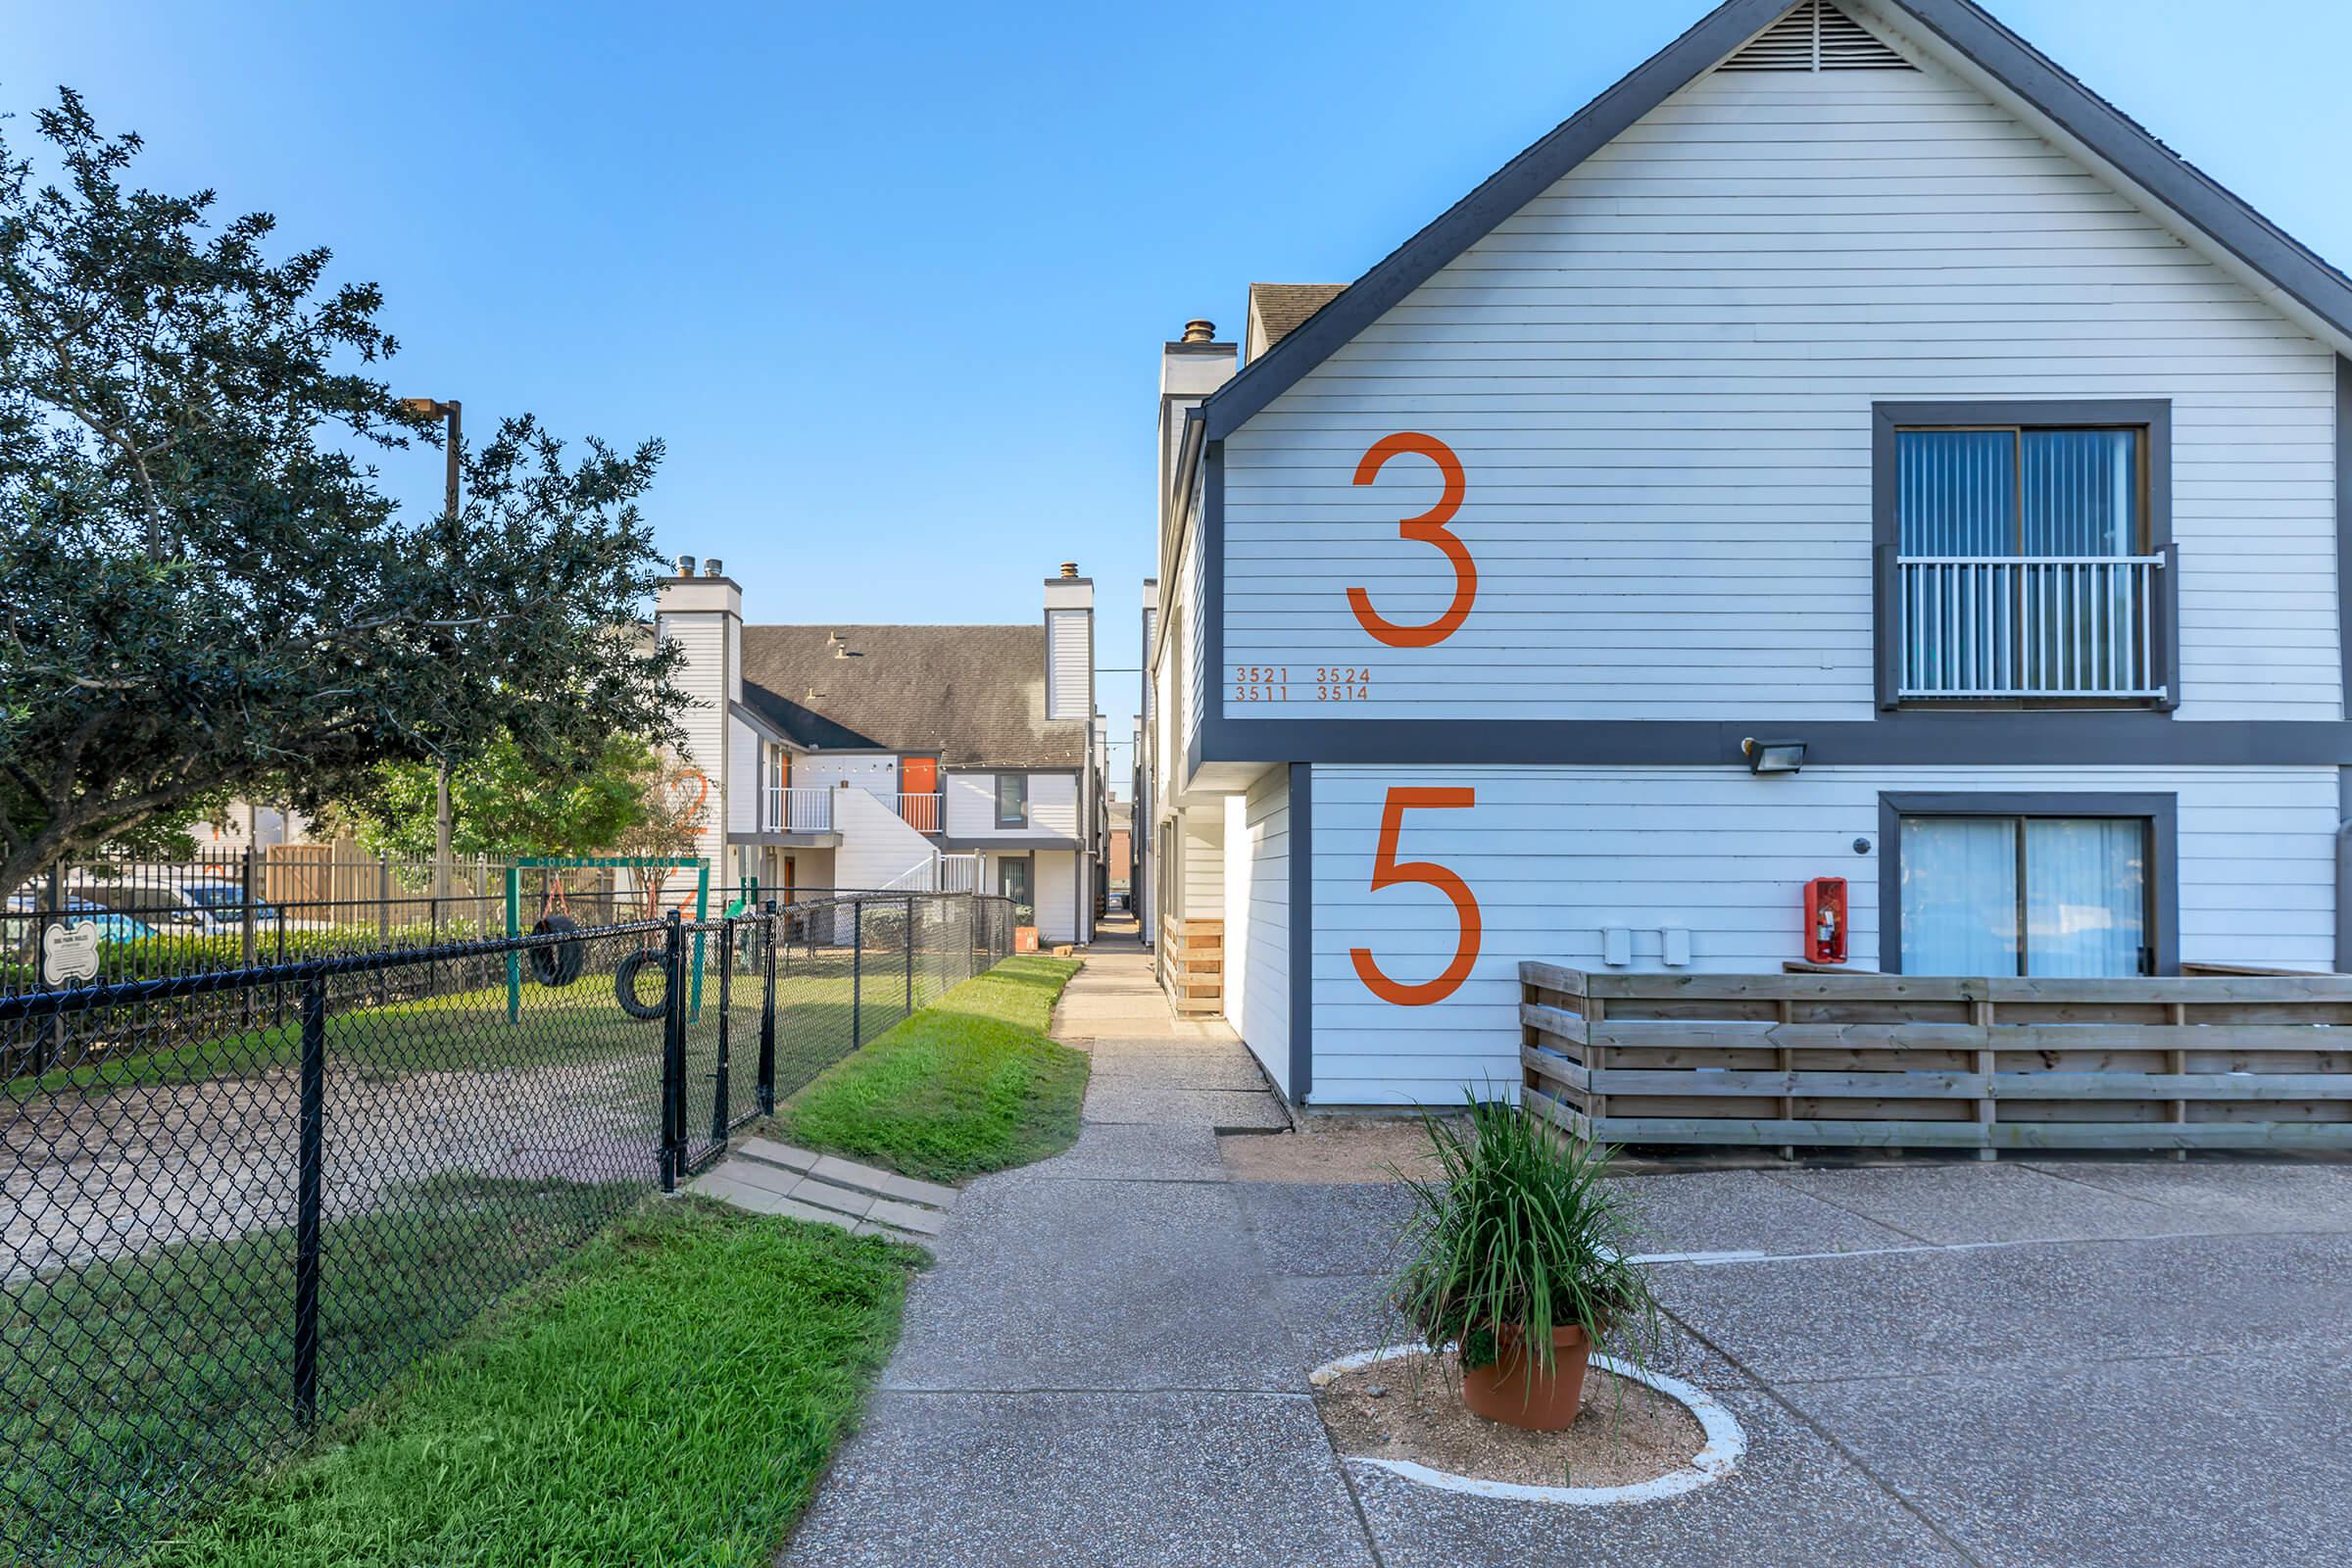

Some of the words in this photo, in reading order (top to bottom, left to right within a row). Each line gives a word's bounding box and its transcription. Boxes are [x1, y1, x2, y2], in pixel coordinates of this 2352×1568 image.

[1346, 431, 1478, 648] 3
[1235, 685, 1287, 702] 3511
[1317, 685, 1367, 701] 3514
[1236, 667, 1287, 683] 3521
[1316, 667, 1370, 683] 3524
[670, 768, 709, 834] 2
[594, 857, 621, 868] PET
[642, 857, 681, 868] PARK
[1349, 787, 1482, 1006] 5
